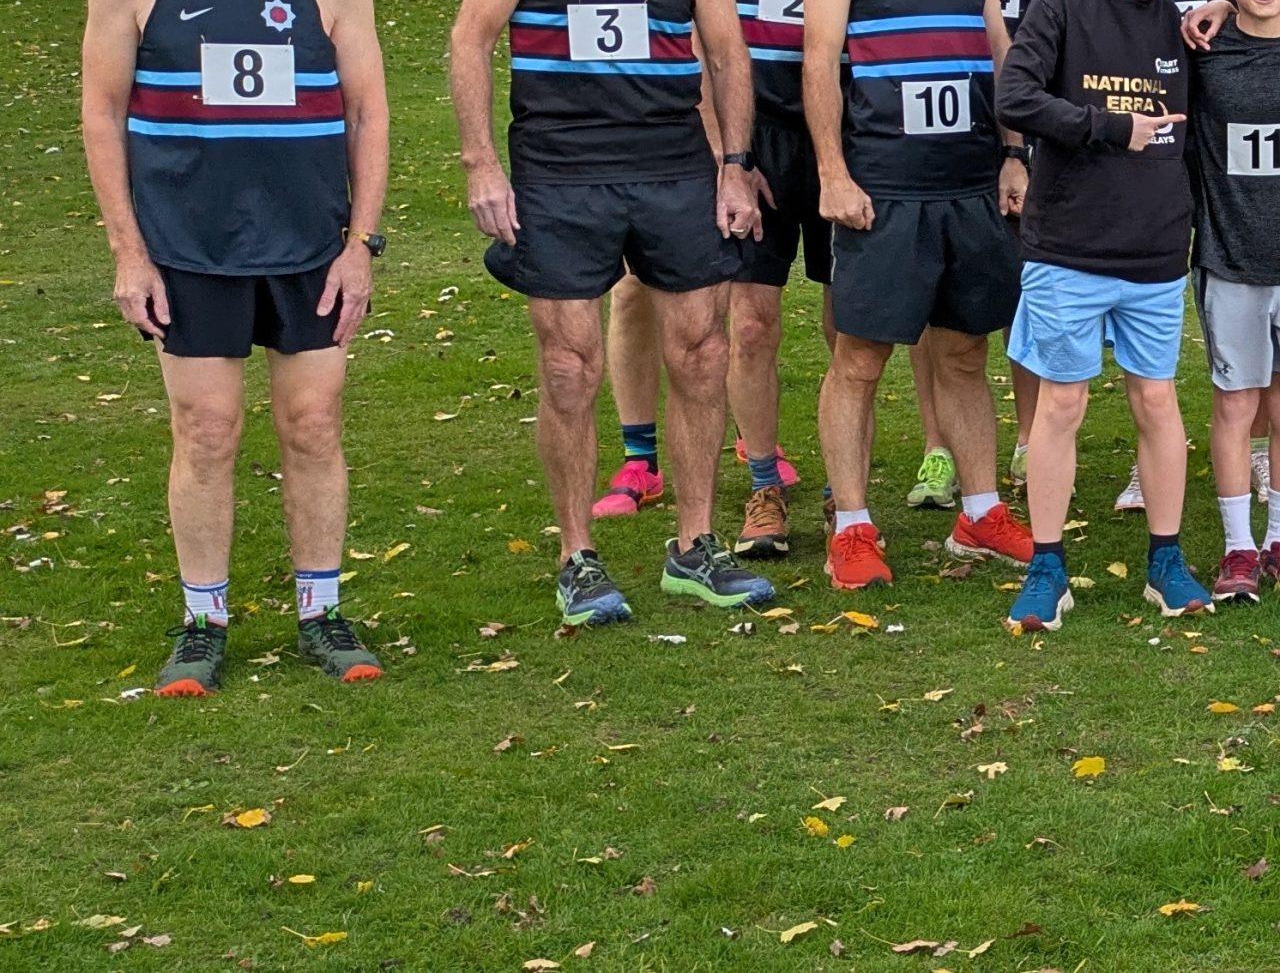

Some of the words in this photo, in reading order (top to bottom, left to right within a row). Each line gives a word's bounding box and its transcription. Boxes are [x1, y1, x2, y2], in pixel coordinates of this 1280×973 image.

[596, 8, 623, 54] 3
[233, 48, 264, 98] 8
[1083, 74, 1166, 94] NATIONAL
[915, 84, 959, 128] 10
[1106, 95, 1154, 112] ERRA
[1150, 135, 1175, 144] ELAYS
[1242, 128, 1280, 169] 11
